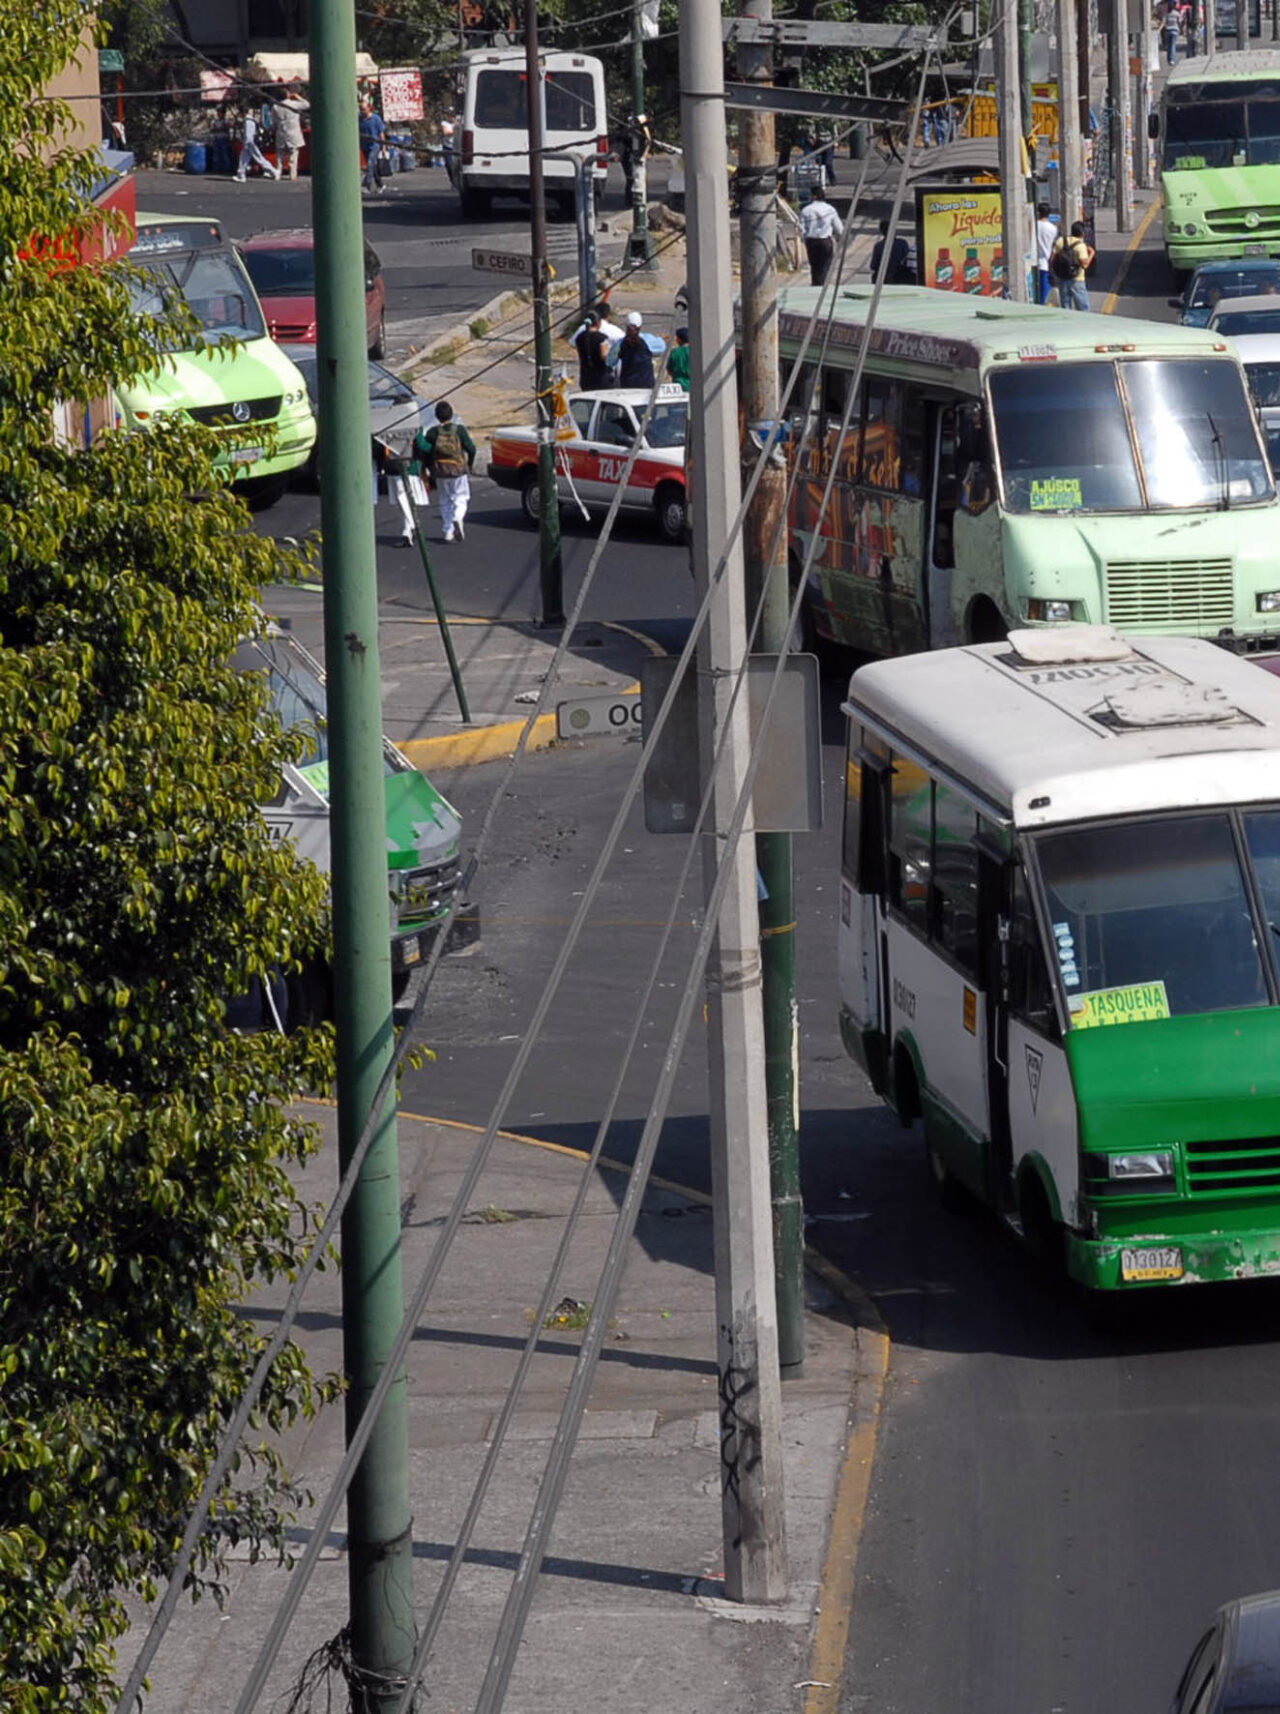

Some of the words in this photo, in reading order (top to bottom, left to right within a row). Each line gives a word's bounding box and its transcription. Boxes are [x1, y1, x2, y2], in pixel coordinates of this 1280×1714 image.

[929, 201, 960, 214] Ahora
[961, 200, 978, 209] las
[489, 254, 526, 271] CEFIRO
[886, 331, 918, 357] Price
[918, 336, 951, 365] Shoes
[661, 385, 680, 395] TAXI
[598, 457, 630, 481] TAX
[1032, 479, 1080, 494] AJUSCO
[1088, 986, 1163, 1017] TASQUENA
